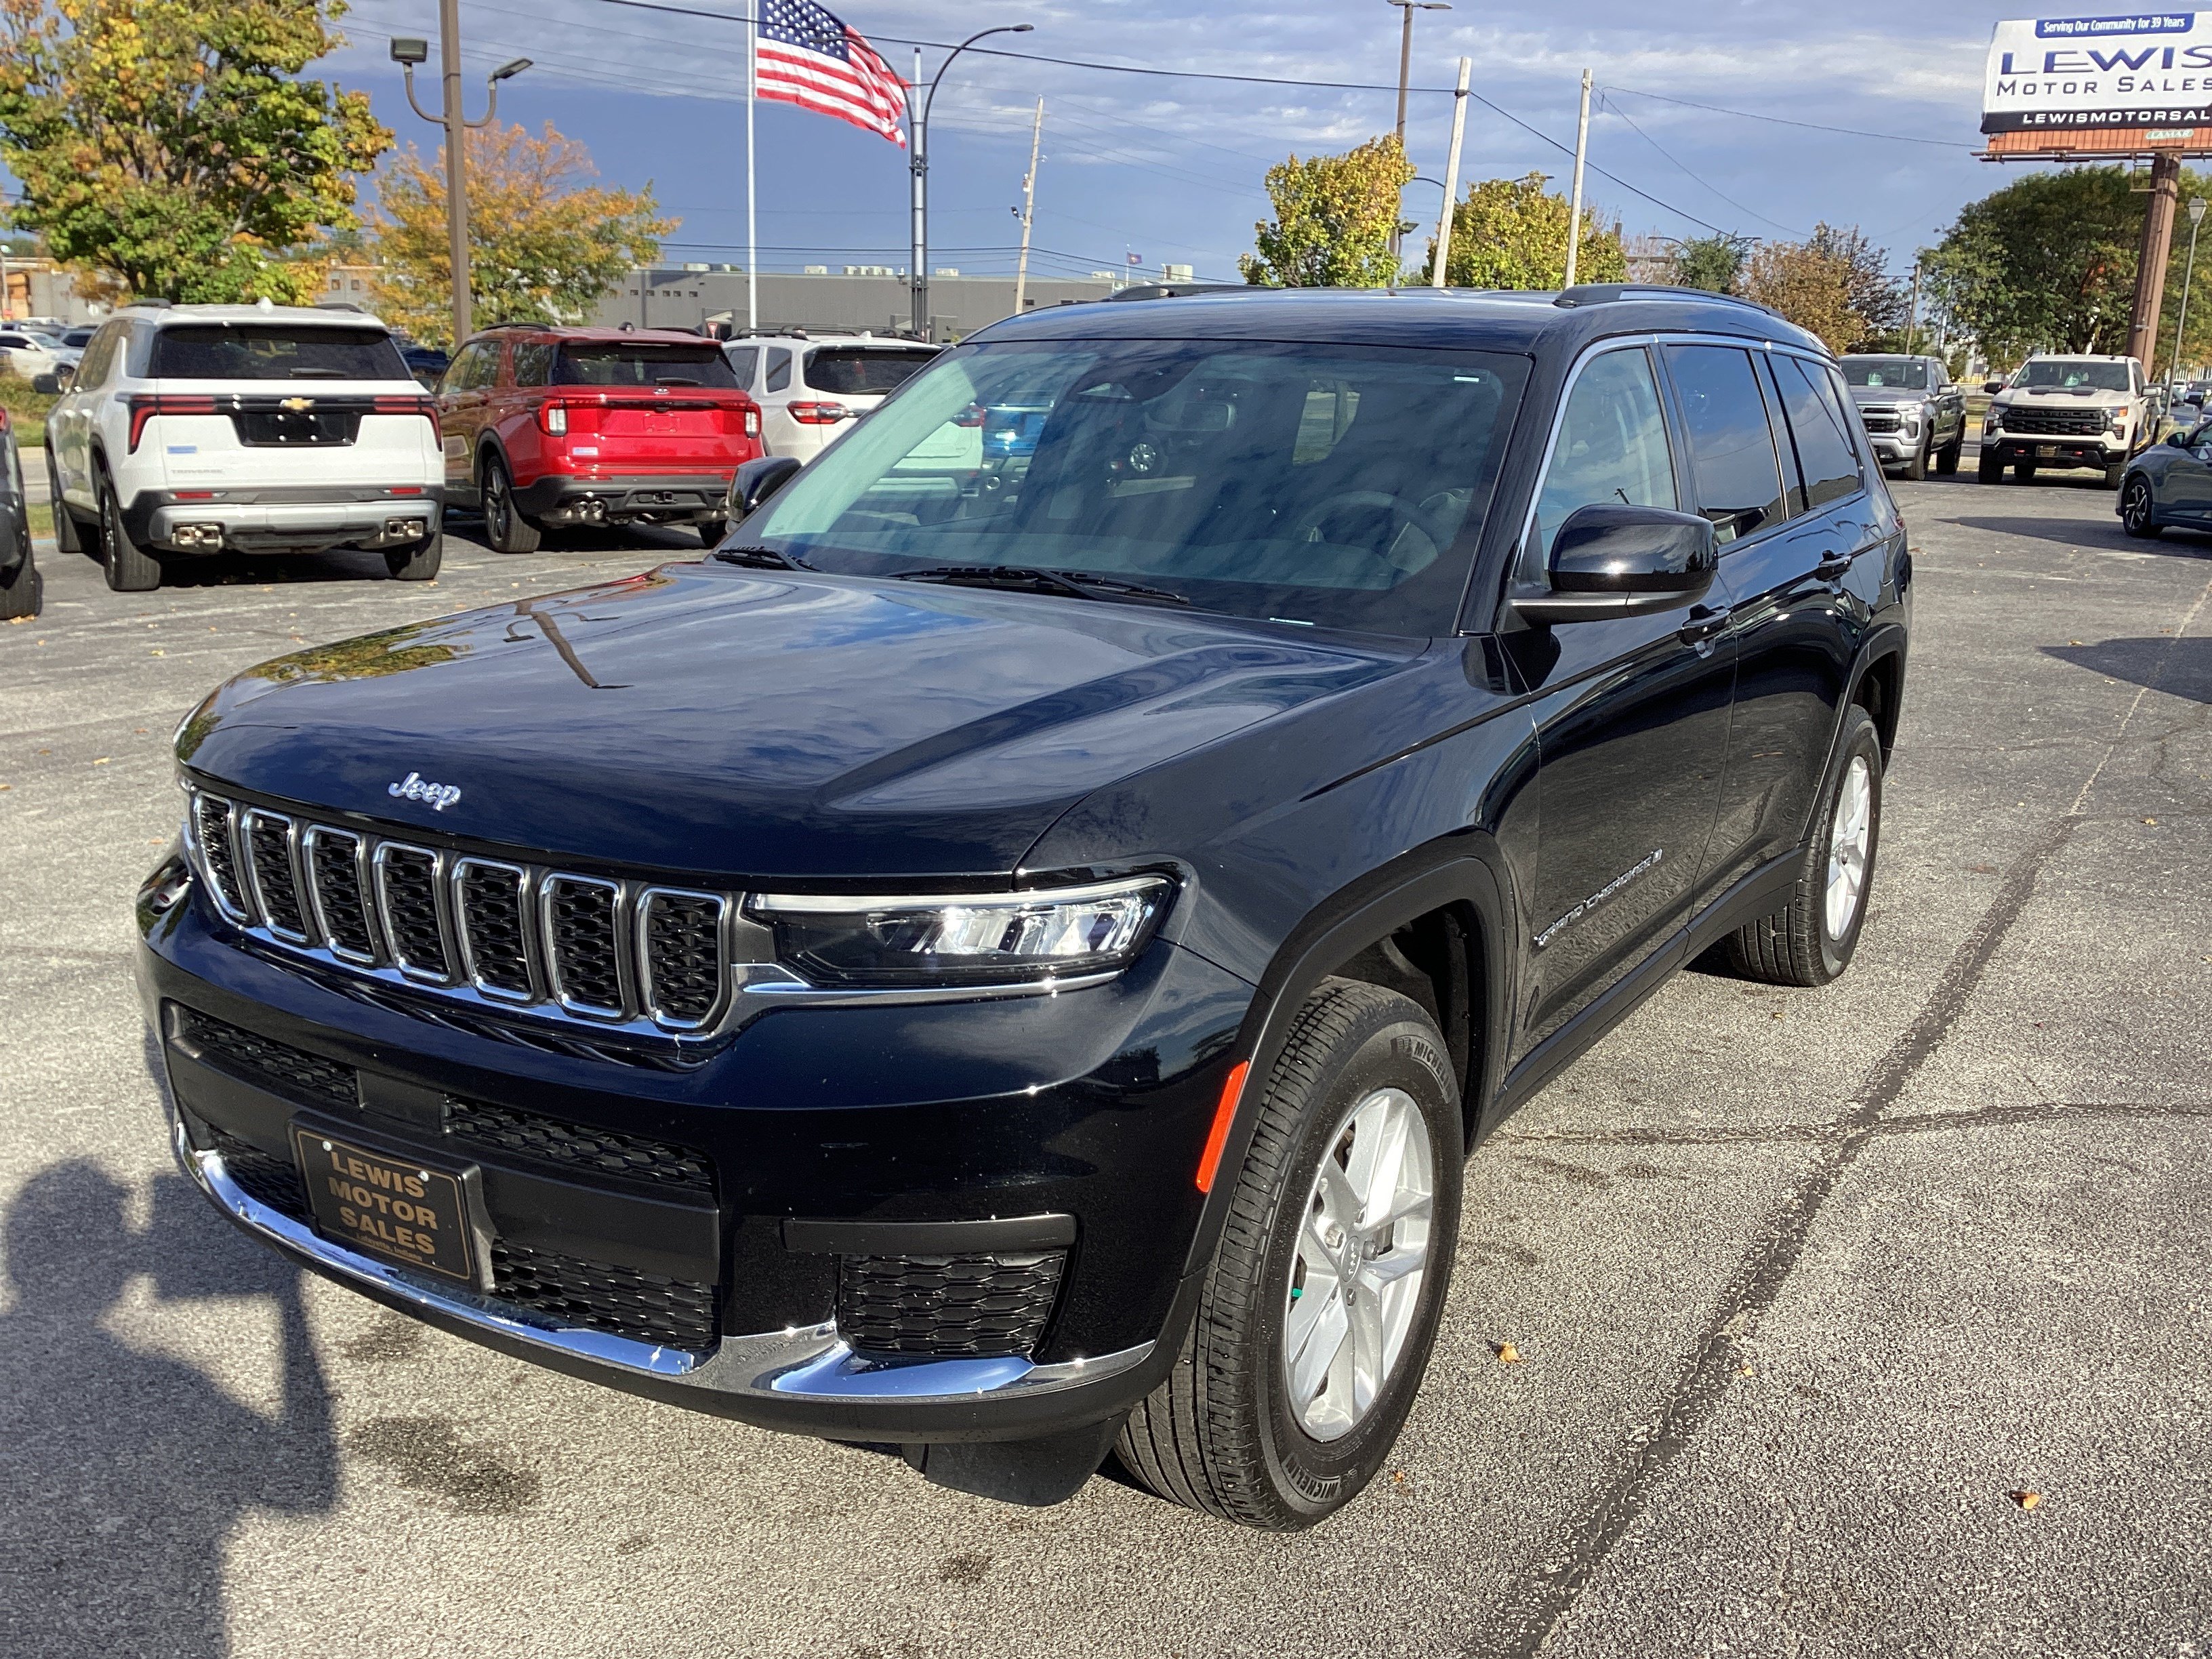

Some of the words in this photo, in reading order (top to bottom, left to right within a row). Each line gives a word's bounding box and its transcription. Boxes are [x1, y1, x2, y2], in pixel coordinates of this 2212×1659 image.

[2043, 21, 2073, 33] Serving
[2075, 21, 2089, 31] Our
[2091, 19, 2135, 32] Community
[2137, 17, 2150, 29] for
[2151, 16, 2162, 28] 39
[2164, 16, 2186, 28] Years
[2001, 45, 2212, 75] LEWIS
[1996, 79, 2099, 96] MOTOR
[2116, 76, 2212, 92] SALES
[388, 771, 462, 811] Jeep
[331, 1151, 426, 1199] LEWIS
[329, 1176, 439, 1231] MOTOR
[340, 1206, 436, 1255] SALES
[1285, 1459, 1339, 1499] MICHELIN
